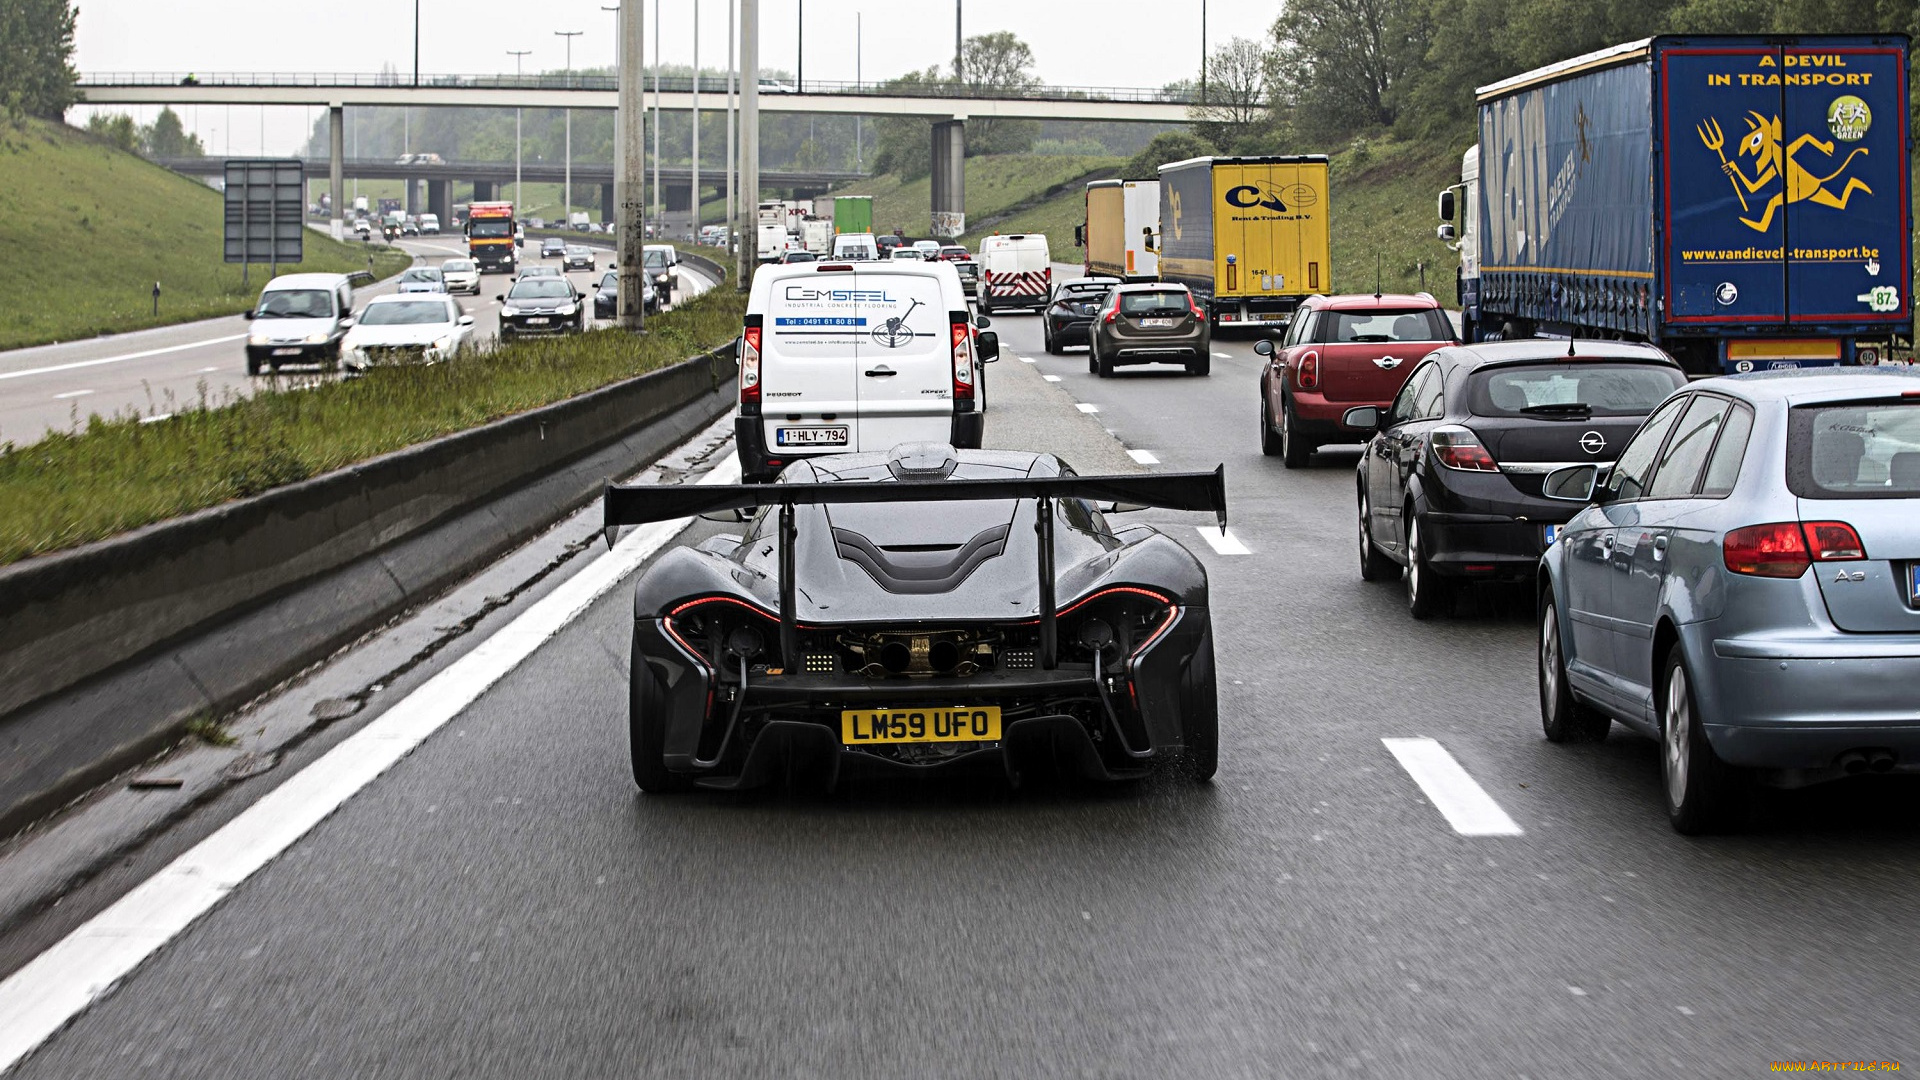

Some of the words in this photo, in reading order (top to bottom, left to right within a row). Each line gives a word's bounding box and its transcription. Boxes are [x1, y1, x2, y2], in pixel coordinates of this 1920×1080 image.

[1759, 55, 1776, 67] A
[1784, 54, 1846, 67] DEVIL
[1708, 73, 1731, 86] IN
[1738, 73, 1873, 86] TRANSPORT
[1832, 125, 1852, 133] LEAN
[1837, 131, 1863, 139] GREEN
[788, 208, 807, 216] XPO
[1876, 292, 1891, 305] 87
[1834, 568, 1866, 583] A3
[853, 713, 926, 739] LM59
[934, 710, 988, 737] UFO
